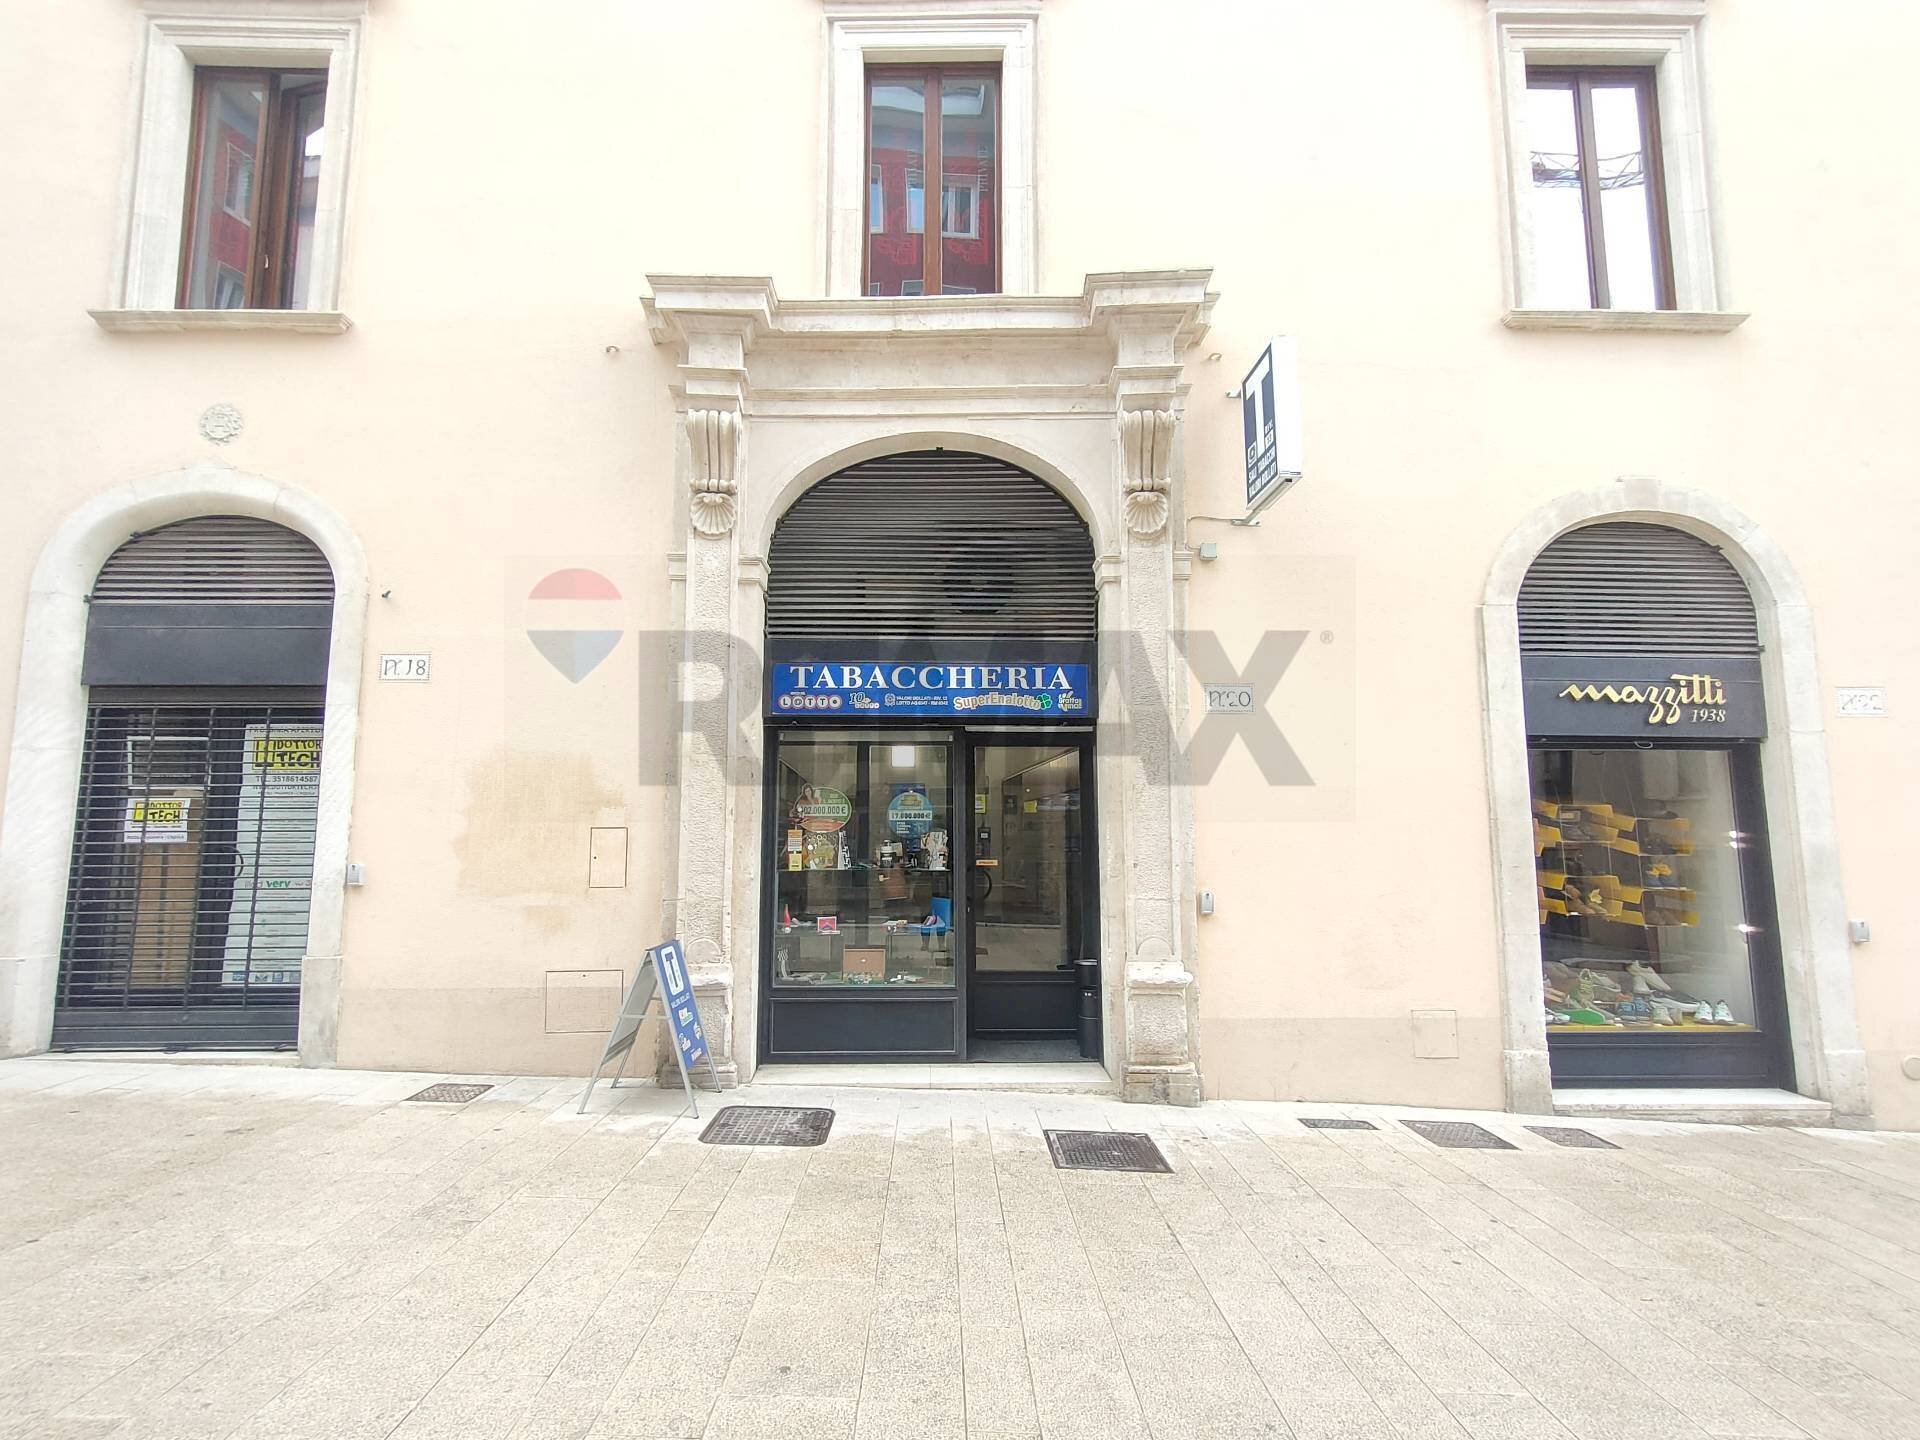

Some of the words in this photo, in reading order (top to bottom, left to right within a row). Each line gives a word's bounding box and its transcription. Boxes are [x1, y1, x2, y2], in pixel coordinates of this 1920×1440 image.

[1246, 352, 1271, 459] T
[790, 665, 1072, 690] TABACCHERIA
[780, 694, 842, 709] LOTTO
[953, 692, 1042, 710] SuperEnalotto
[1559, 674, 1726, 725] mazzitti
[1690, 709, 1727, 723] 1938
[276, 751, 321, 768] TECH
[149, 810, 180, 823] TECH
